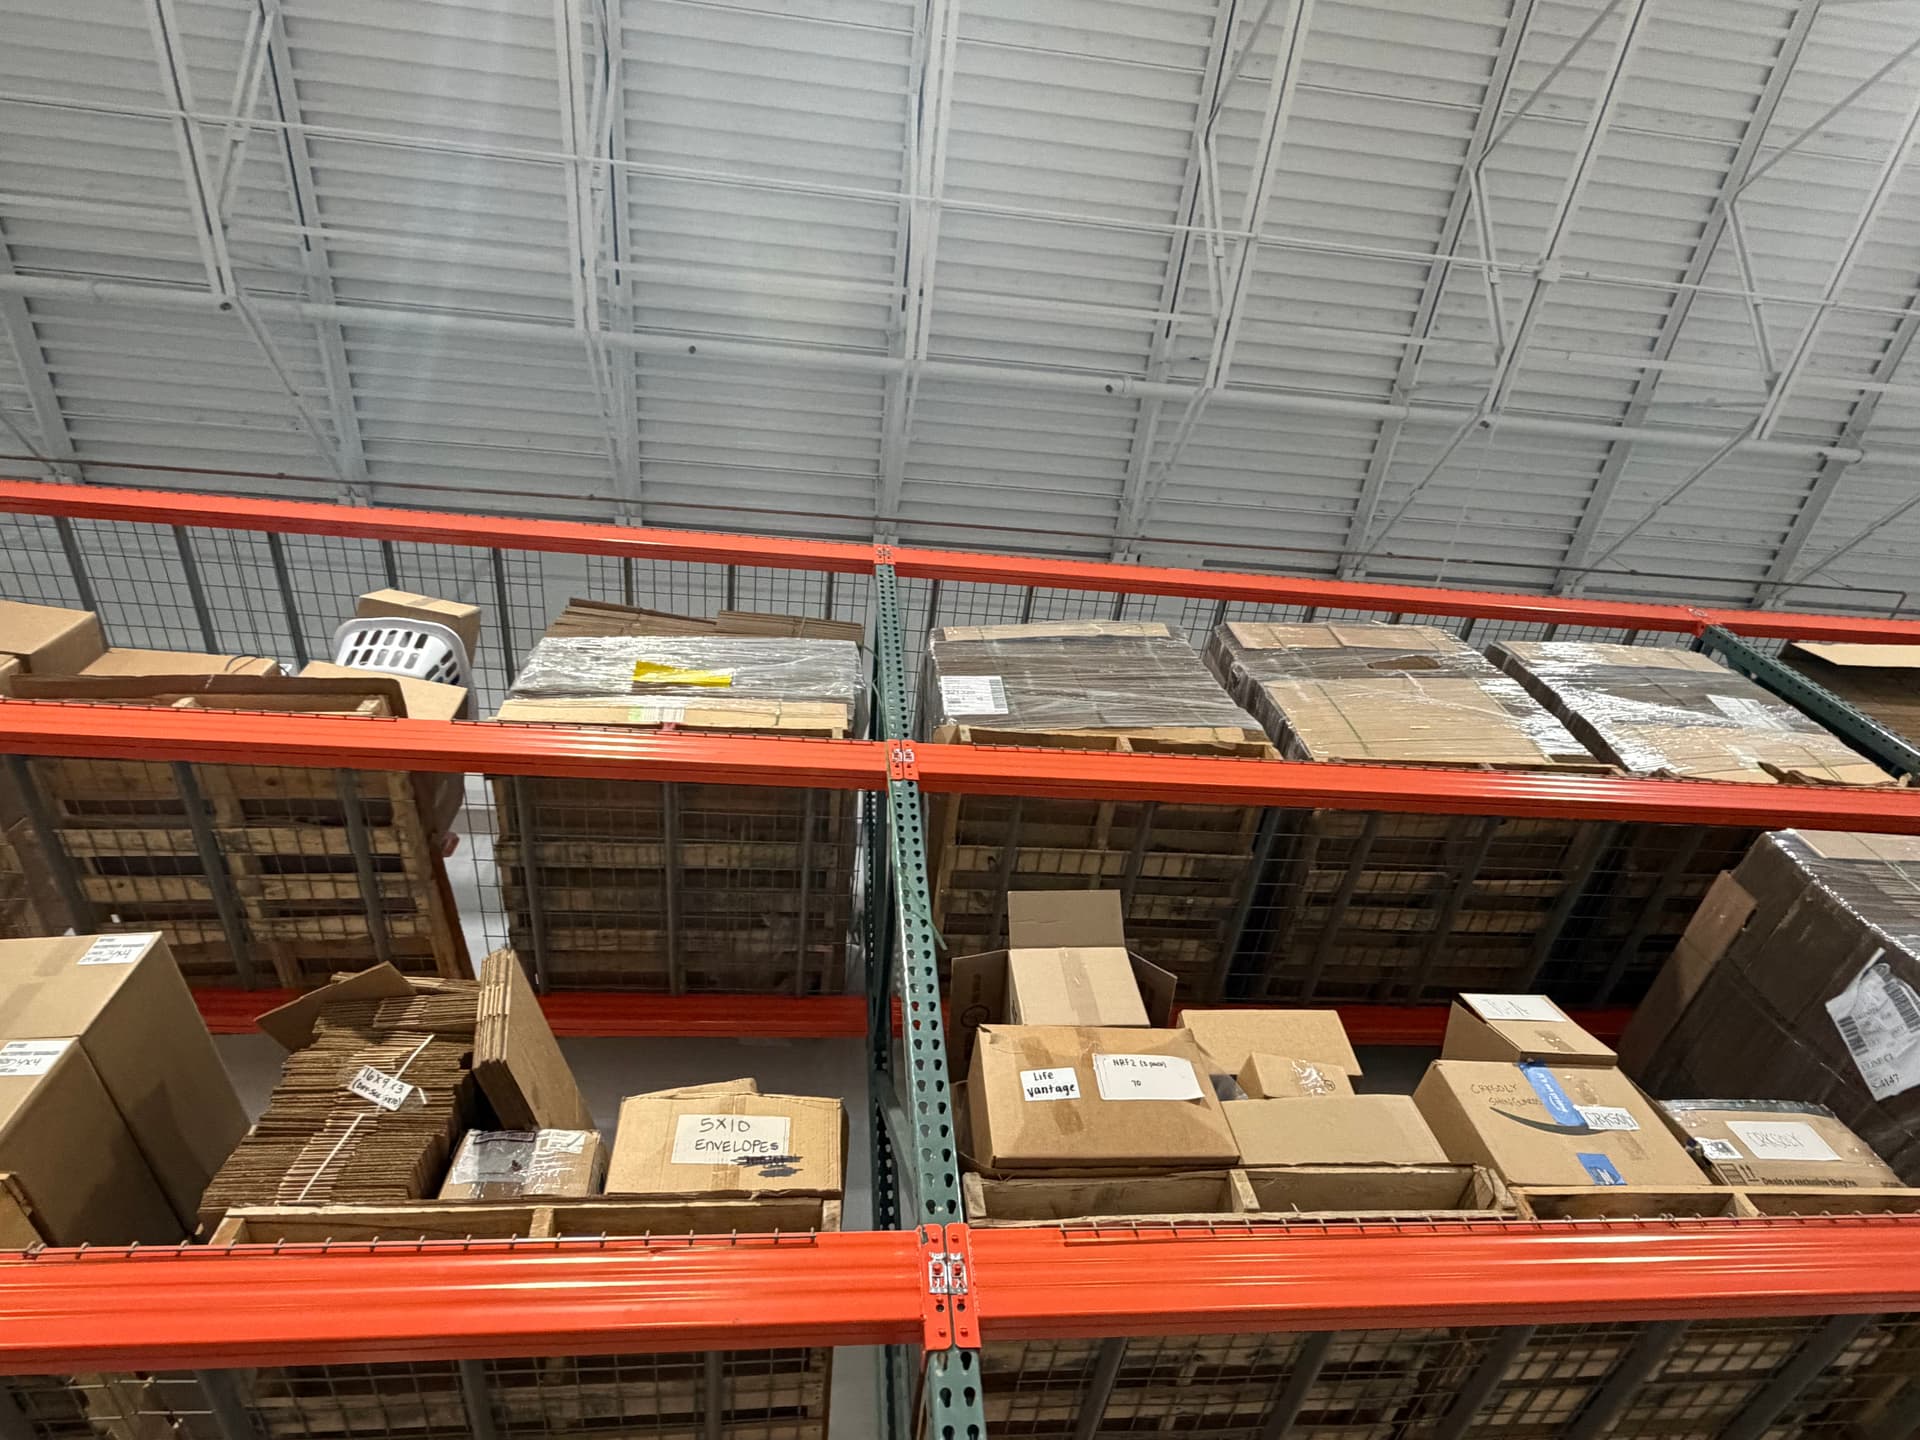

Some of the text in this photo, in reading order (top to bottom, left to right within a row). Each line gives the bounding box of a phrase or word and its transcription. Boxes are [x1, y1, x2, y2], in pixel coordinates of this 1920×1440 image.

[1033, 1071, 1054, 1082] Life
[1026, 1084, 1076, 1098] vantage
[699, 1118, 751, 1132] 5X10
[694, 1138, 779, 1153] ENVELOPES
